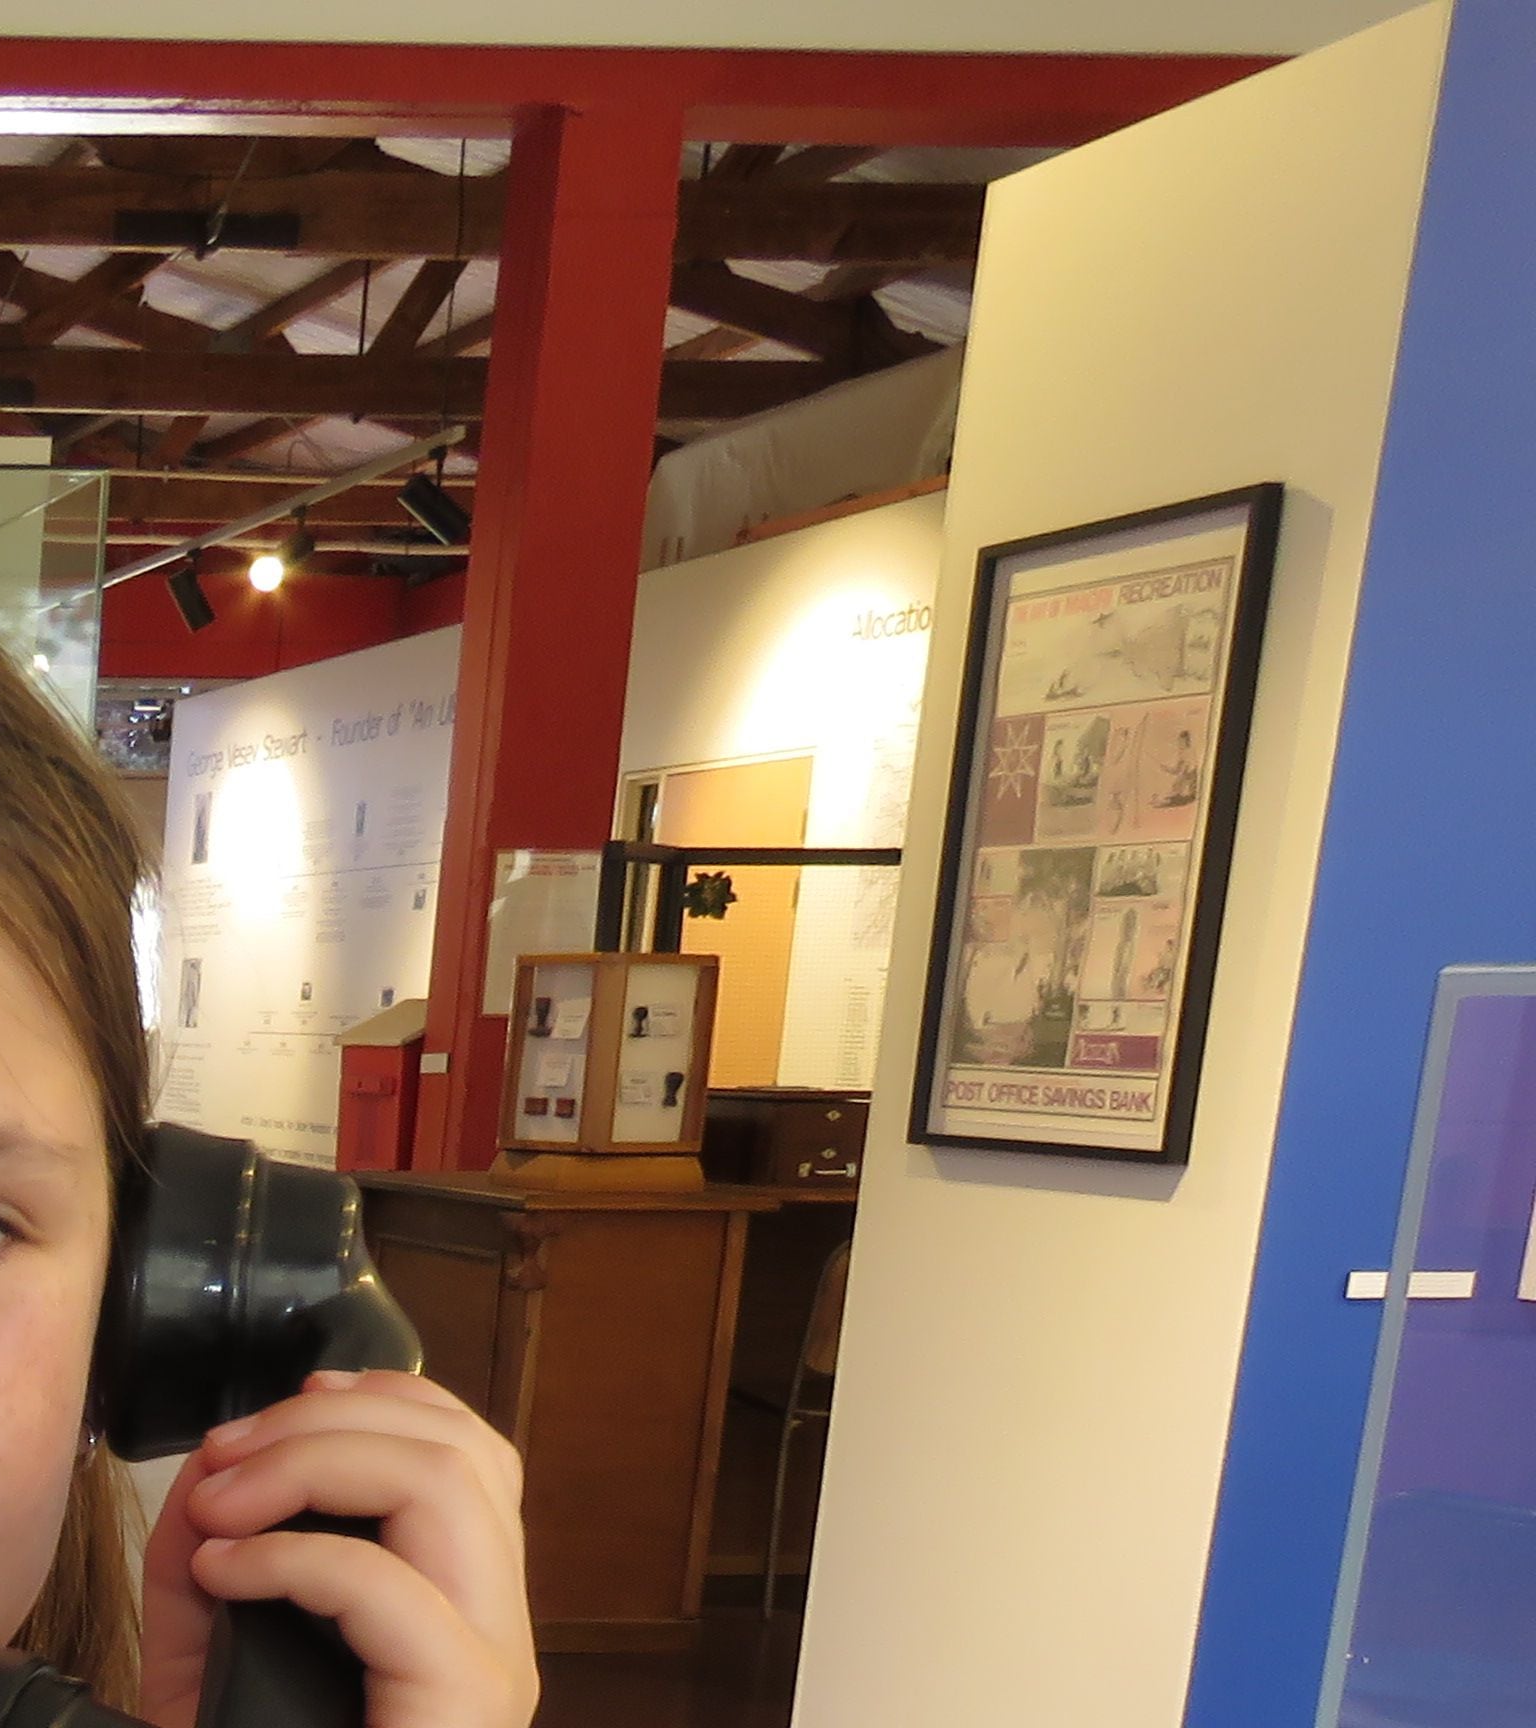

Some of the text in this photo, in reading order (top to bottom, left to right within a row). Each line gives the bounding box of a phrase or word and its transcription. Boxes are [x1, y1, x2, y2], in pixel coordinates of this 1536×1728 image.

[1118, 567, 1225, 605] RECREATION
[186, 748, 224, 779] George
[263, 729, 308, 762] Stewart
[330, 710, 384, 747] Founder
[387, 701, 404, 737] of
[946, 1079, 985, 1101] POST
[987, 1082, 1039, 1105] OFFICE
[1041, 1085, 1105, 1110] SAVINGS
[1109, 1090, 1153, 1113] BANK
